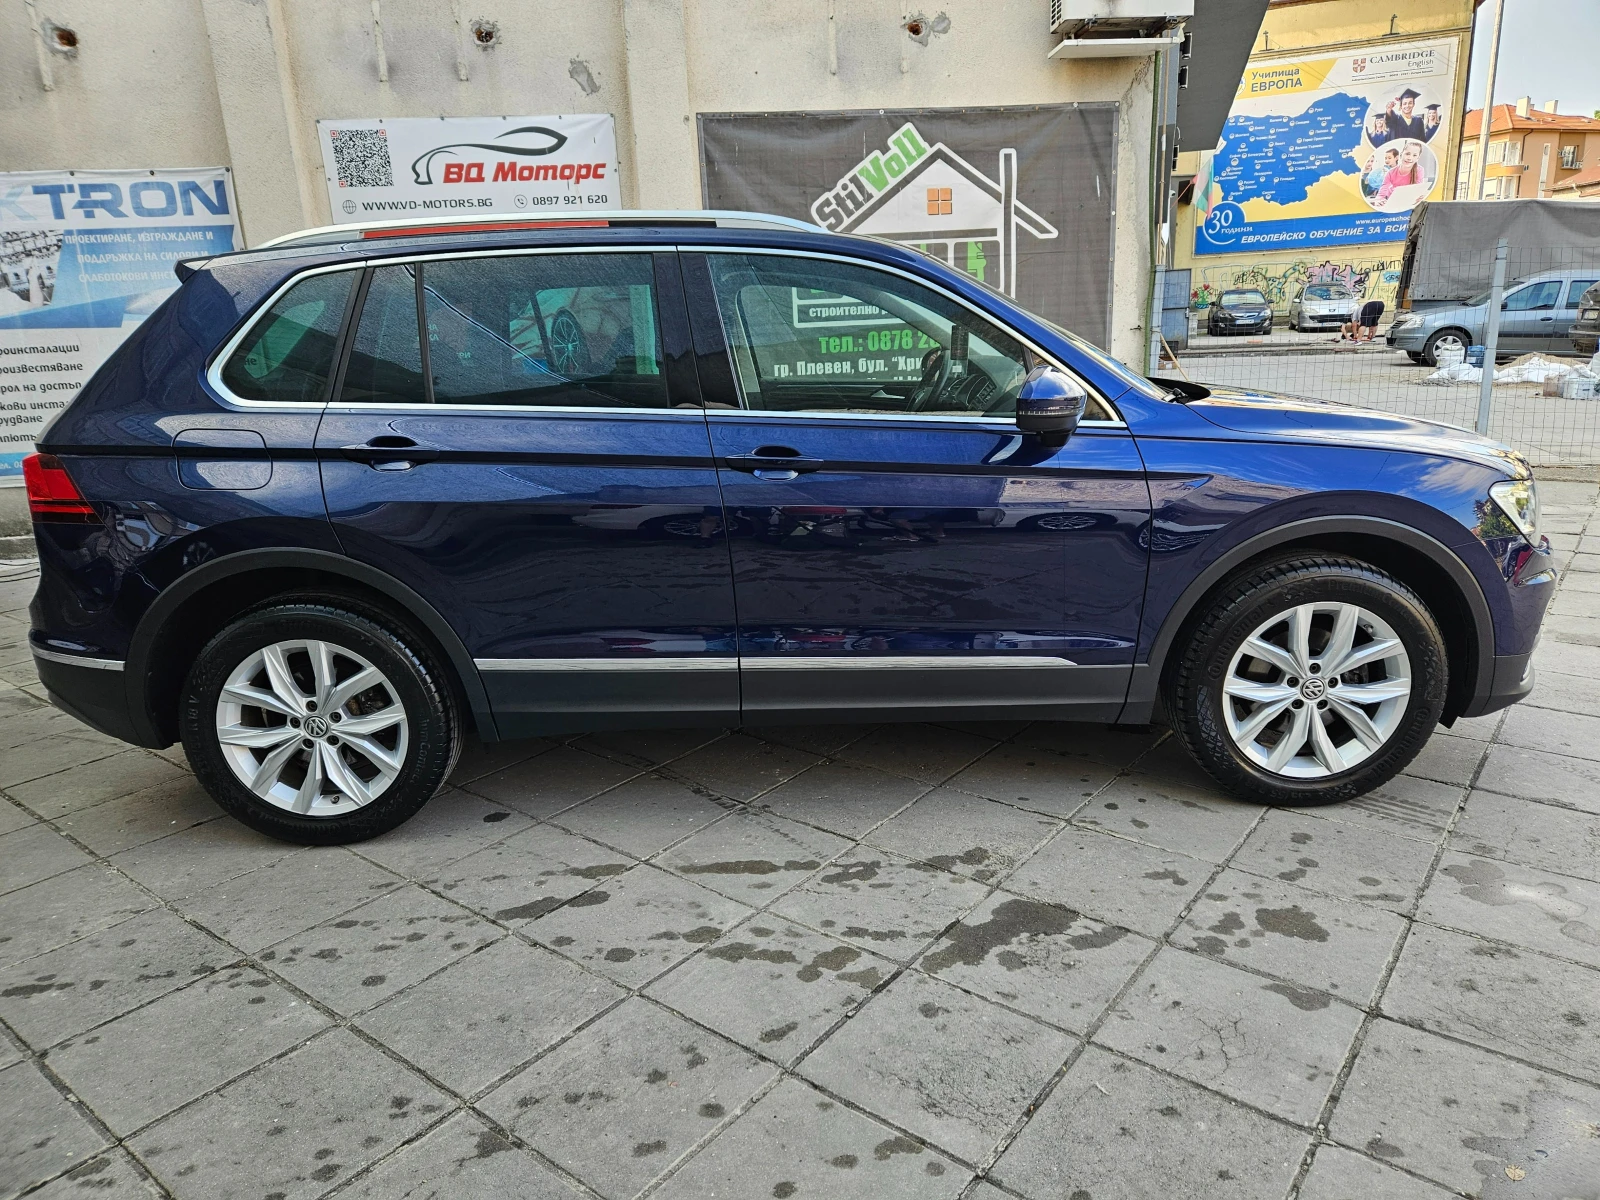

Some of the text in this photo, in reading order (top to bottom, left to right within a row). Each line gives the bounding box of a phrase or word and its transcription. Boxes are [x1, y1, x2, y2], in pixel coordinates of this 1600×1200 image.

[1370, 50, 1435, 64] CAMBRIDGE
[1408, 59, 1434, 68] English
[1252, 68, 1300, 80] Училища
[1251, 78, 1302, 92] ЕВРОПА
[443, 161, 607, 185] ВД Моторс
[362, 198, 493, 211] WWW.VD-MOTORS.BG
[532, 194, 608, 206] 0897 921 620
[1208, 209, 1233, 234] 30
[1221, 226, 1253, 235] години
[1241, 231, 1306, 244] ЕВРОПЕЙСКО
[1309, 227, 1364, 239] ОБУЧЕНИЕ
[1367, 226, 1381, 235] ЗА
[65, 231, 213, 245] ПРОЕКТИРАНЕ, ИЗГРАЖДАНЕ И
[77, 252, 142, 264] ПОДДРЪЖКА
[144, 252, 158, 261] НА
[79, 271, 176, 283] СЛАБОТОКОВИ ИНСТ
[809, 305, 880, 318] строително
[819, 335, 864, 354] тел.:
[867, 329, 913, 352] 0878
[774, 364, 793, 378] гр.
[797, 359, 855, 376] Плевен,
[858, 357, 889, 374] бул.
[23, 384, 36, 392] на
[40, 381, 82, 394] достъп
[30, 400, 69, 411] инста
